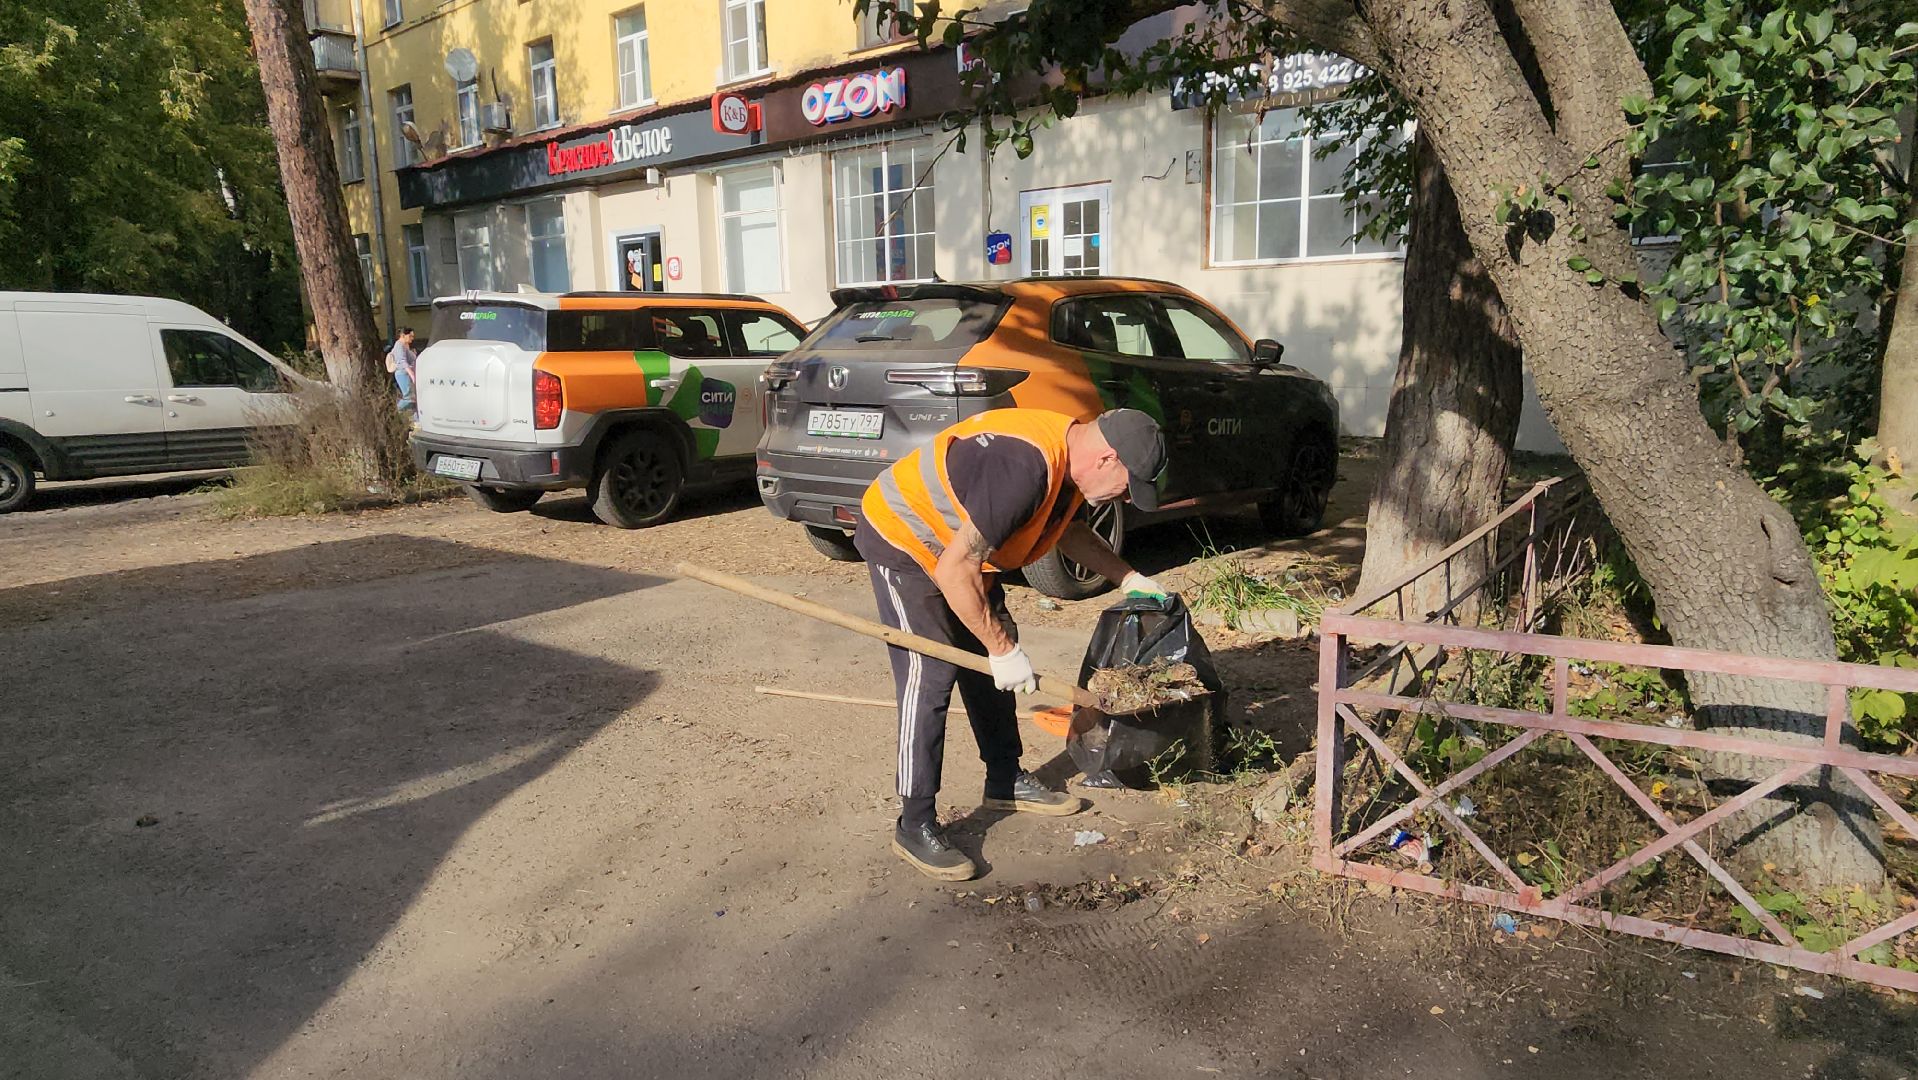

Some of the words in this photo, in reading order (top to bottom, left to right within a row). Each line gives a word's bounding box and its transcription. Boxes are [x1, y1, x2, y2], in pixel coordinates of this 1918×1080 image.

[1283, 69, 1313, 89] 925
[1318, 62, 1348, 83] 422
[801, 68, 906, 125] OZON
[724, 105, 746, 123] К&Б
[986, 239, 1010, 256] OZON
[430, 378, 480, 388] HAVAL
[701, 391, 733, 403] СИТИ
[860, 414, 879, 428] 797
[909, 413, 948, 421] UNI-S
[1207, 417, 1242, 435] СИТИ
